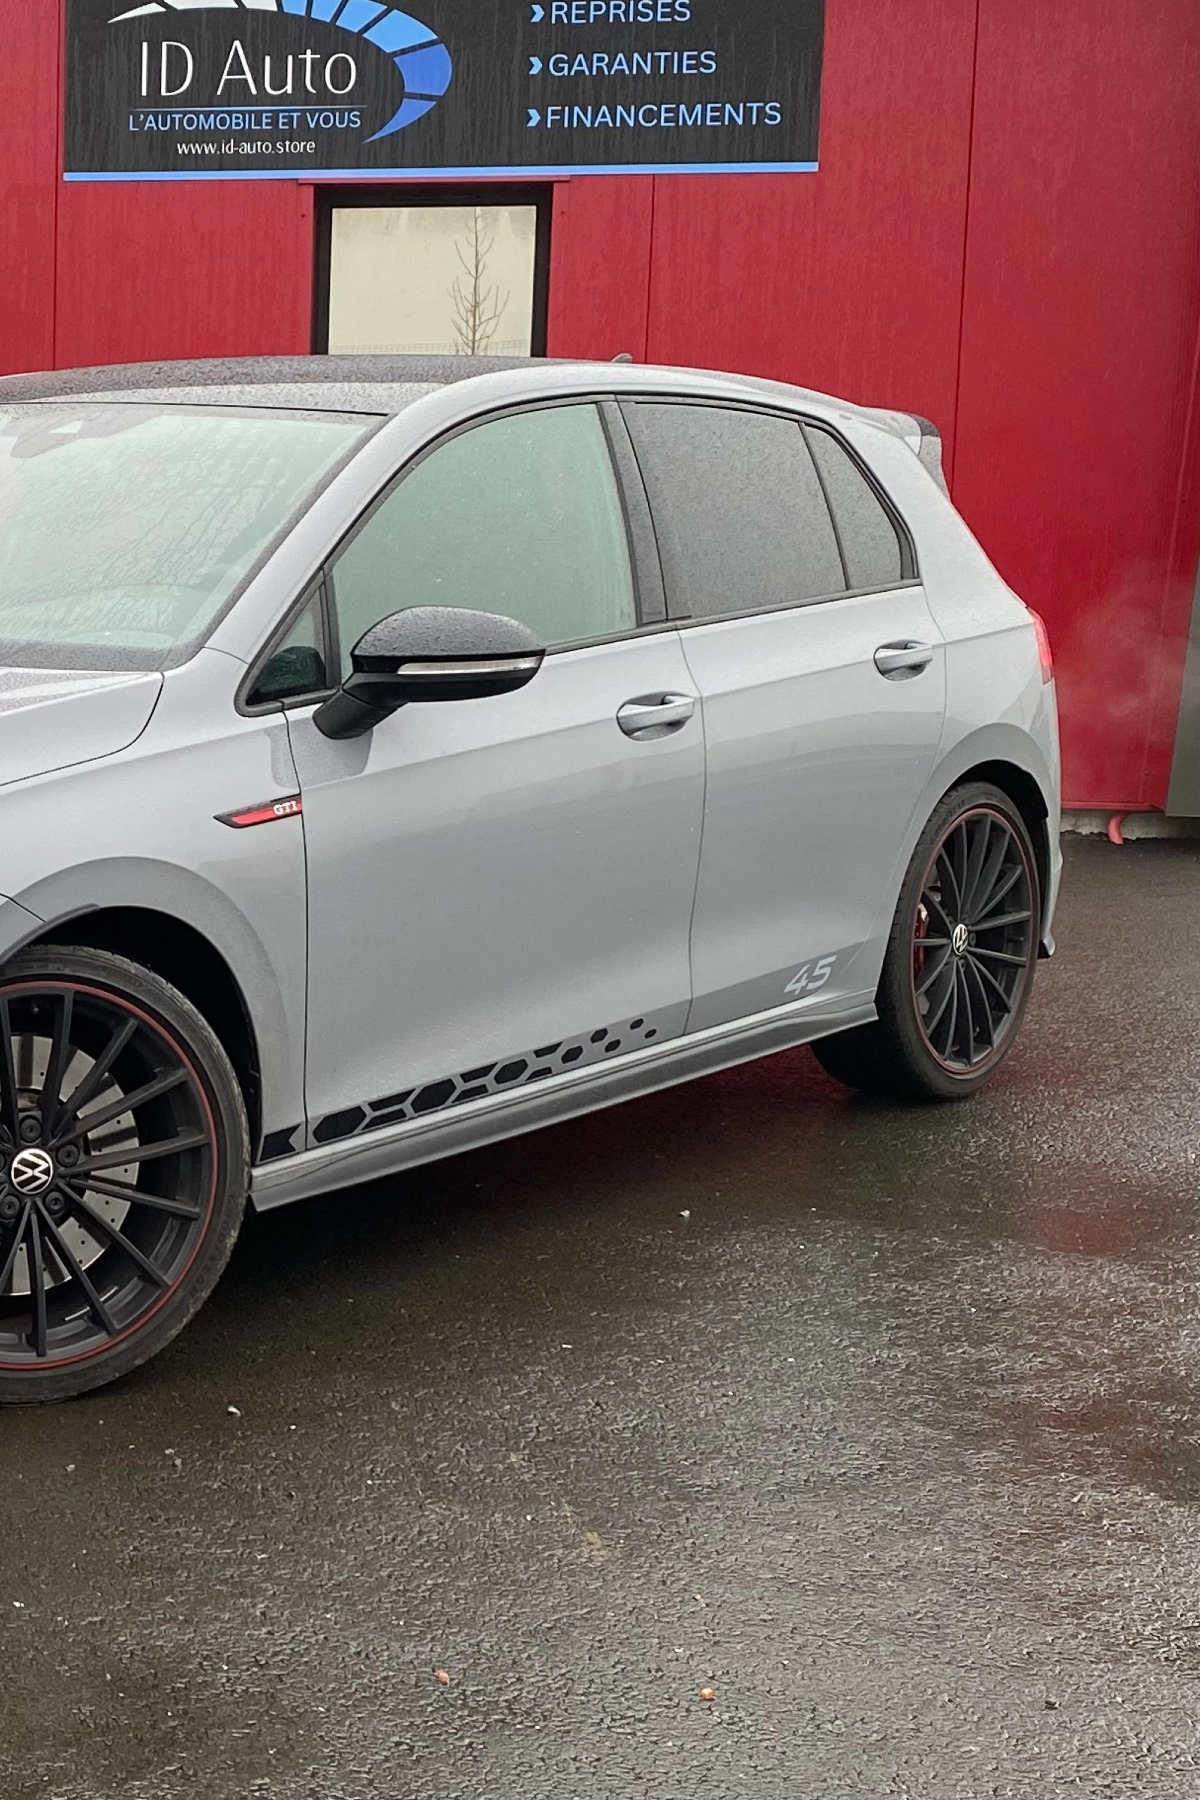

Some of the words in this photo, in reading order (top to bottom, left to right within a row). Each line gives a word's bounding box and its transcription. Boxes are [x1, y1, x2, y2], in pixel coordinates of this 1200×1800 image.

[550, 0, 691, 24] REPRISES
[141, 41, 194, 97] ID
[216, 39, 358, 96] Auto
[548, 50, 717, 77] GARANTIES
[128, 112, 272, 131] L'AUTOMOBILE
[278, 112, 302, 130] ET
[306, 111, 362, 129] VOUS
[546, 102, 782, 129] FINANCEMENTS
[176, 138, 316, 155] www.id-auto.store
[272, 801, 298, 816] GTI
[783, 955, 837, 996] 45
